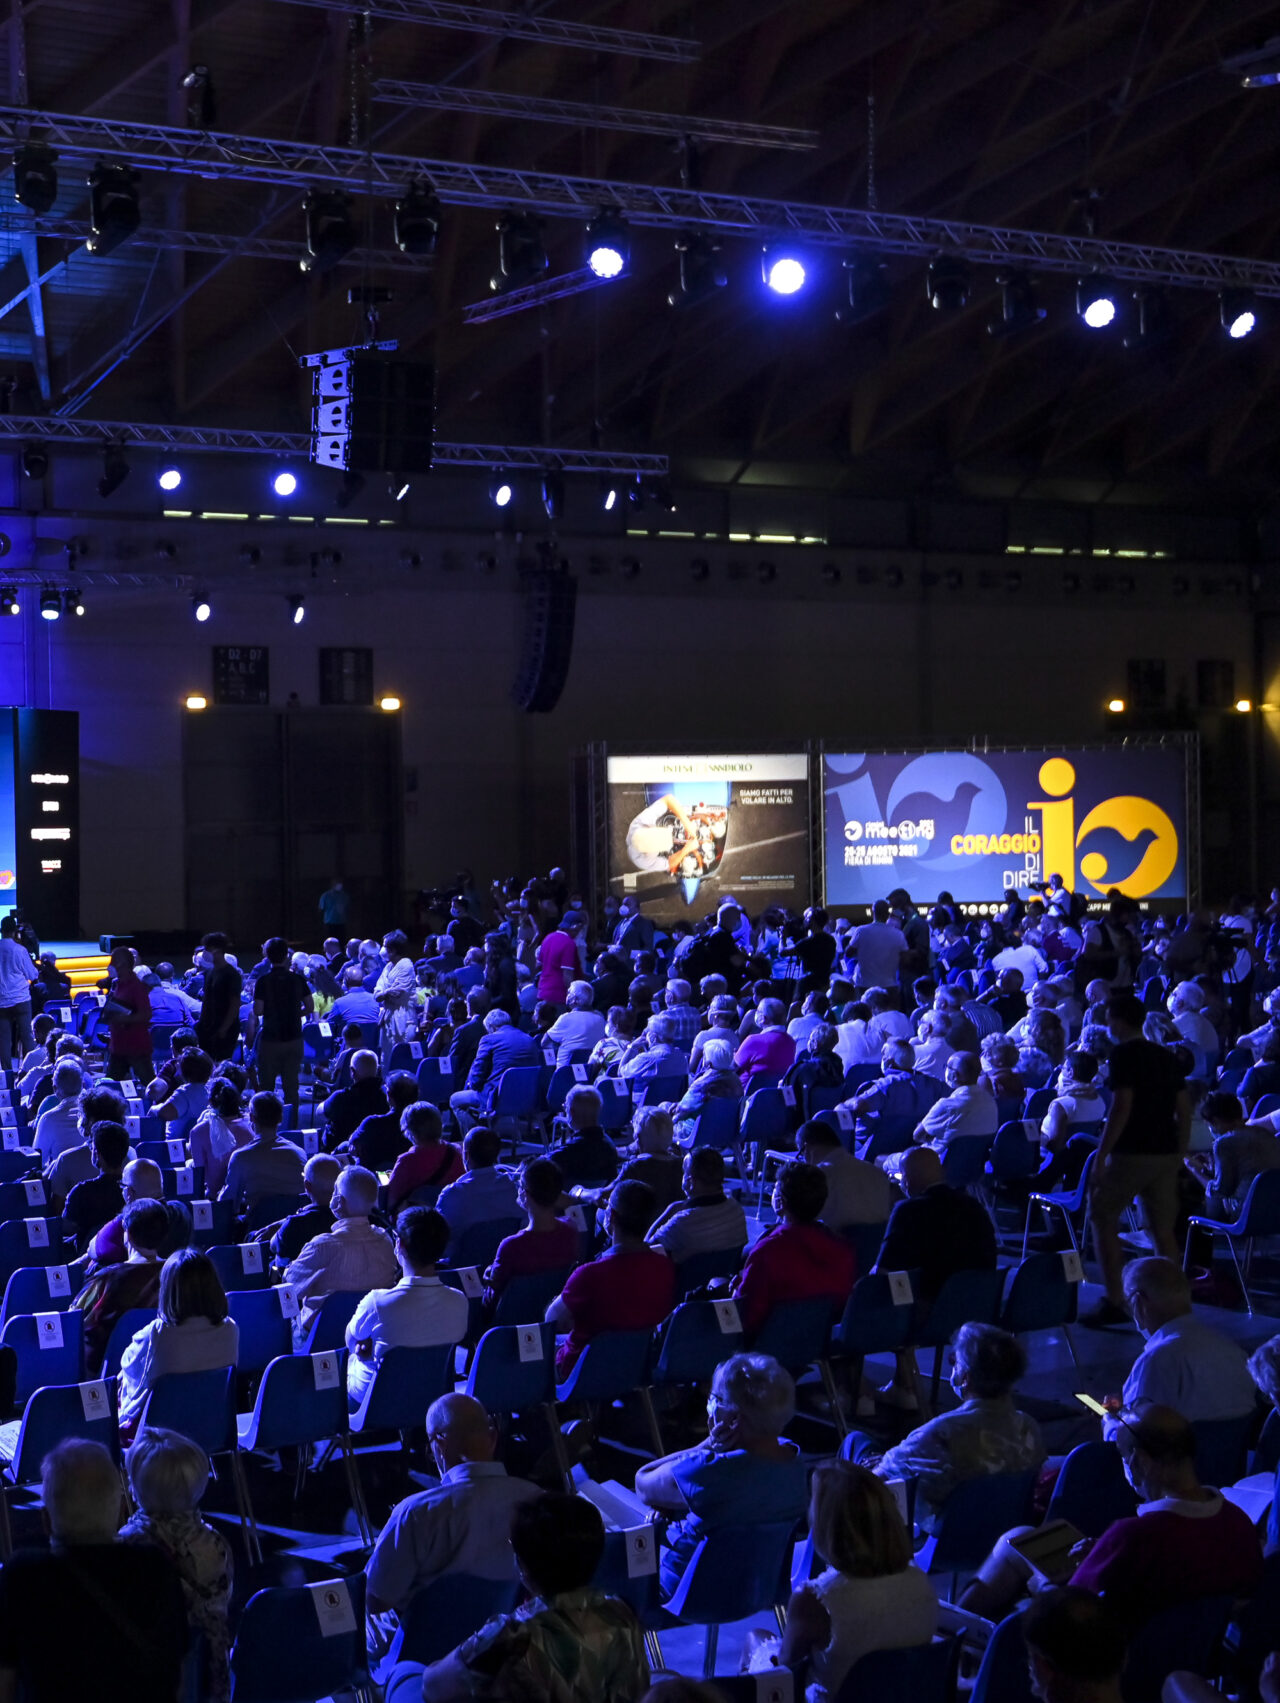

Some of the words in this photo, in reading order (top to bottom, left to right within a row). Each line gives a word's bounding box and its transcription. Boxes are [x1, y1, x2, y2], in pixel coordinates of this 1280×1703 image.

[739, 789, 761, 797] SIAMO
[762, 788, 779, 796] FATTI
[780, 788, 793, 796] PER
[741, 797, 767, 805] VOLARE
[768, 797, 775, 805] IN
[1024, 815, 1039, 834] IL
[950, 833, 1041, 855] CORAGGIO
[1024, 852, 1040, 872] DI
